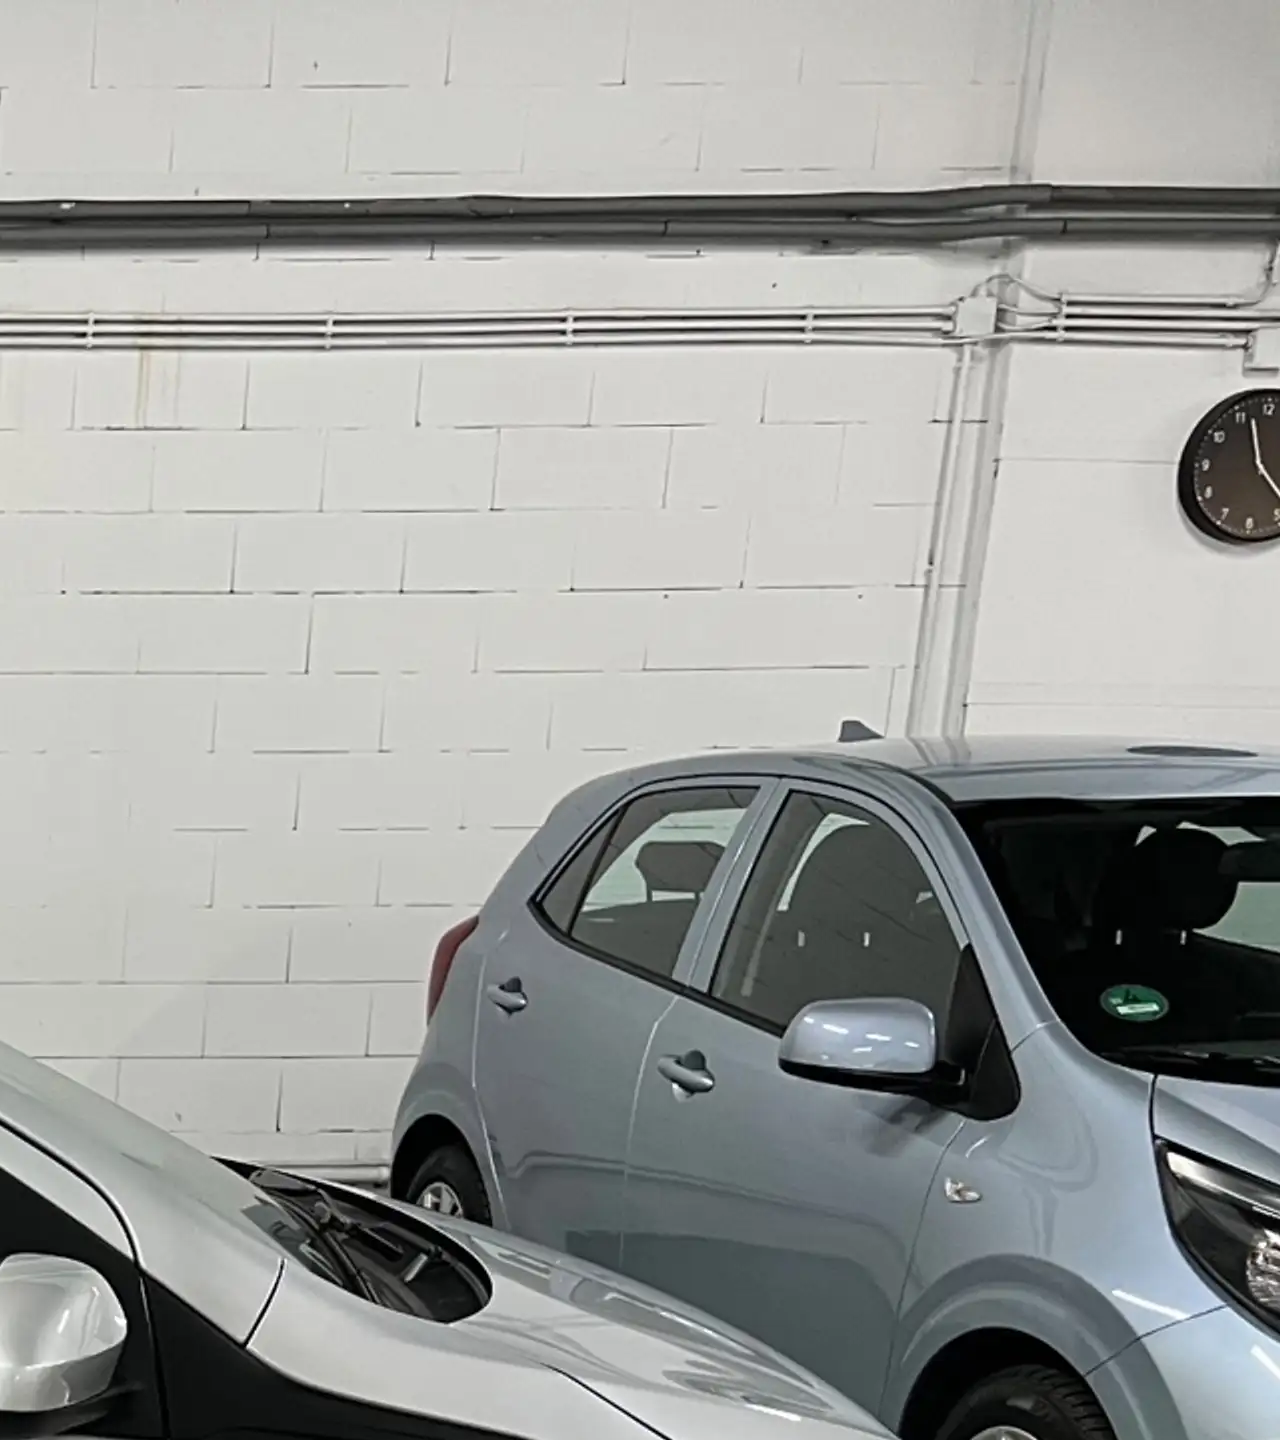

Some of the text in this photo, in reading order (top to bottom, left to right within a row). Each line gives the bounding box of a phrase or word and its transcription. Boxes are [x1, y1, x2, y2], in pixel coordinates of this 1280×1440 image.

[1263, 403, 1275, 416] 12
[1235, 411, 1246, 424] 11
[1213, 431, 1226, 443] 10
[1221, 507, 1230, 520] 7
